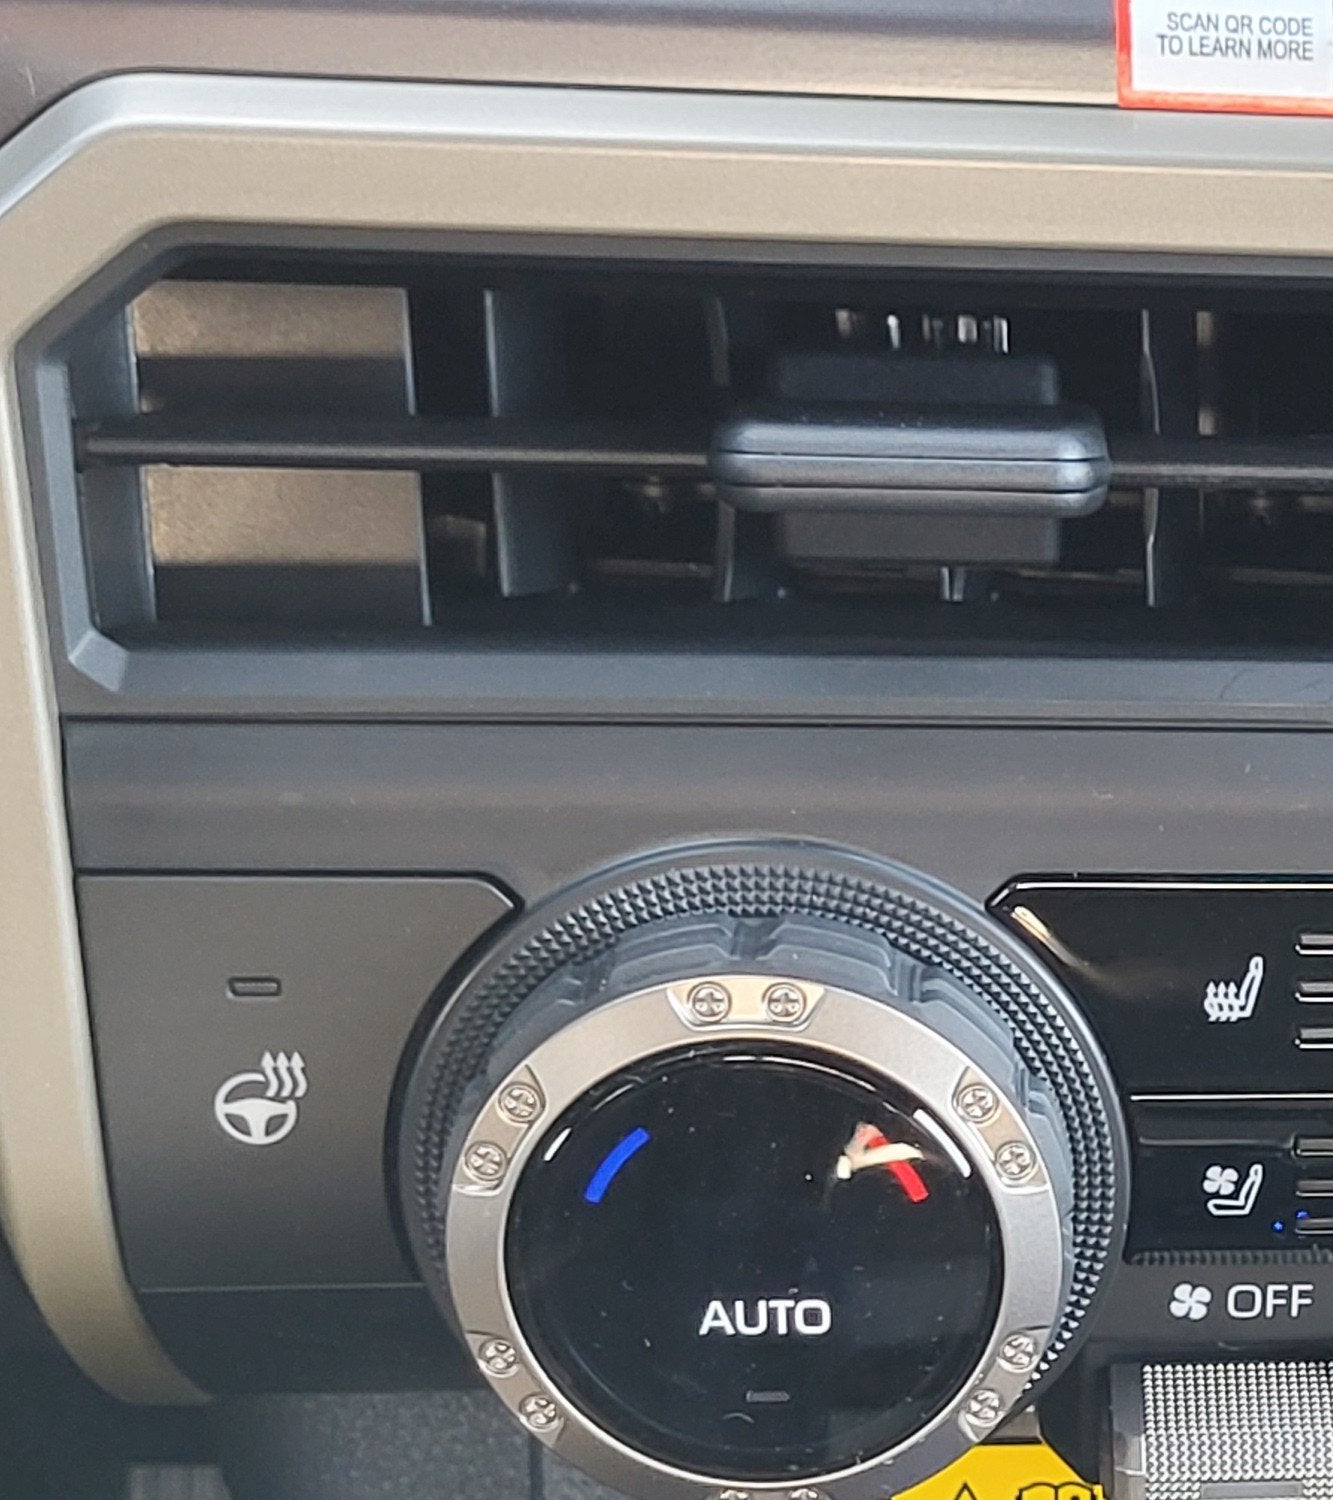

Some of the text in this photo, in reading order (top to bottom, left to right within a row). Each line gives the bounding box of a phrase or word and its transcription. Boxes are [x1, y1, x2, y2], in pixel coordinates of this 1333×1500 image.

[1166, 12, 1313, 37] SCAN QR CODE
[1157, 34, 1314, 61] TO LEARN MORE
[1226, 1283, 1315, 1319] OFF
[698, 1298, 832, 1336] AUTO
